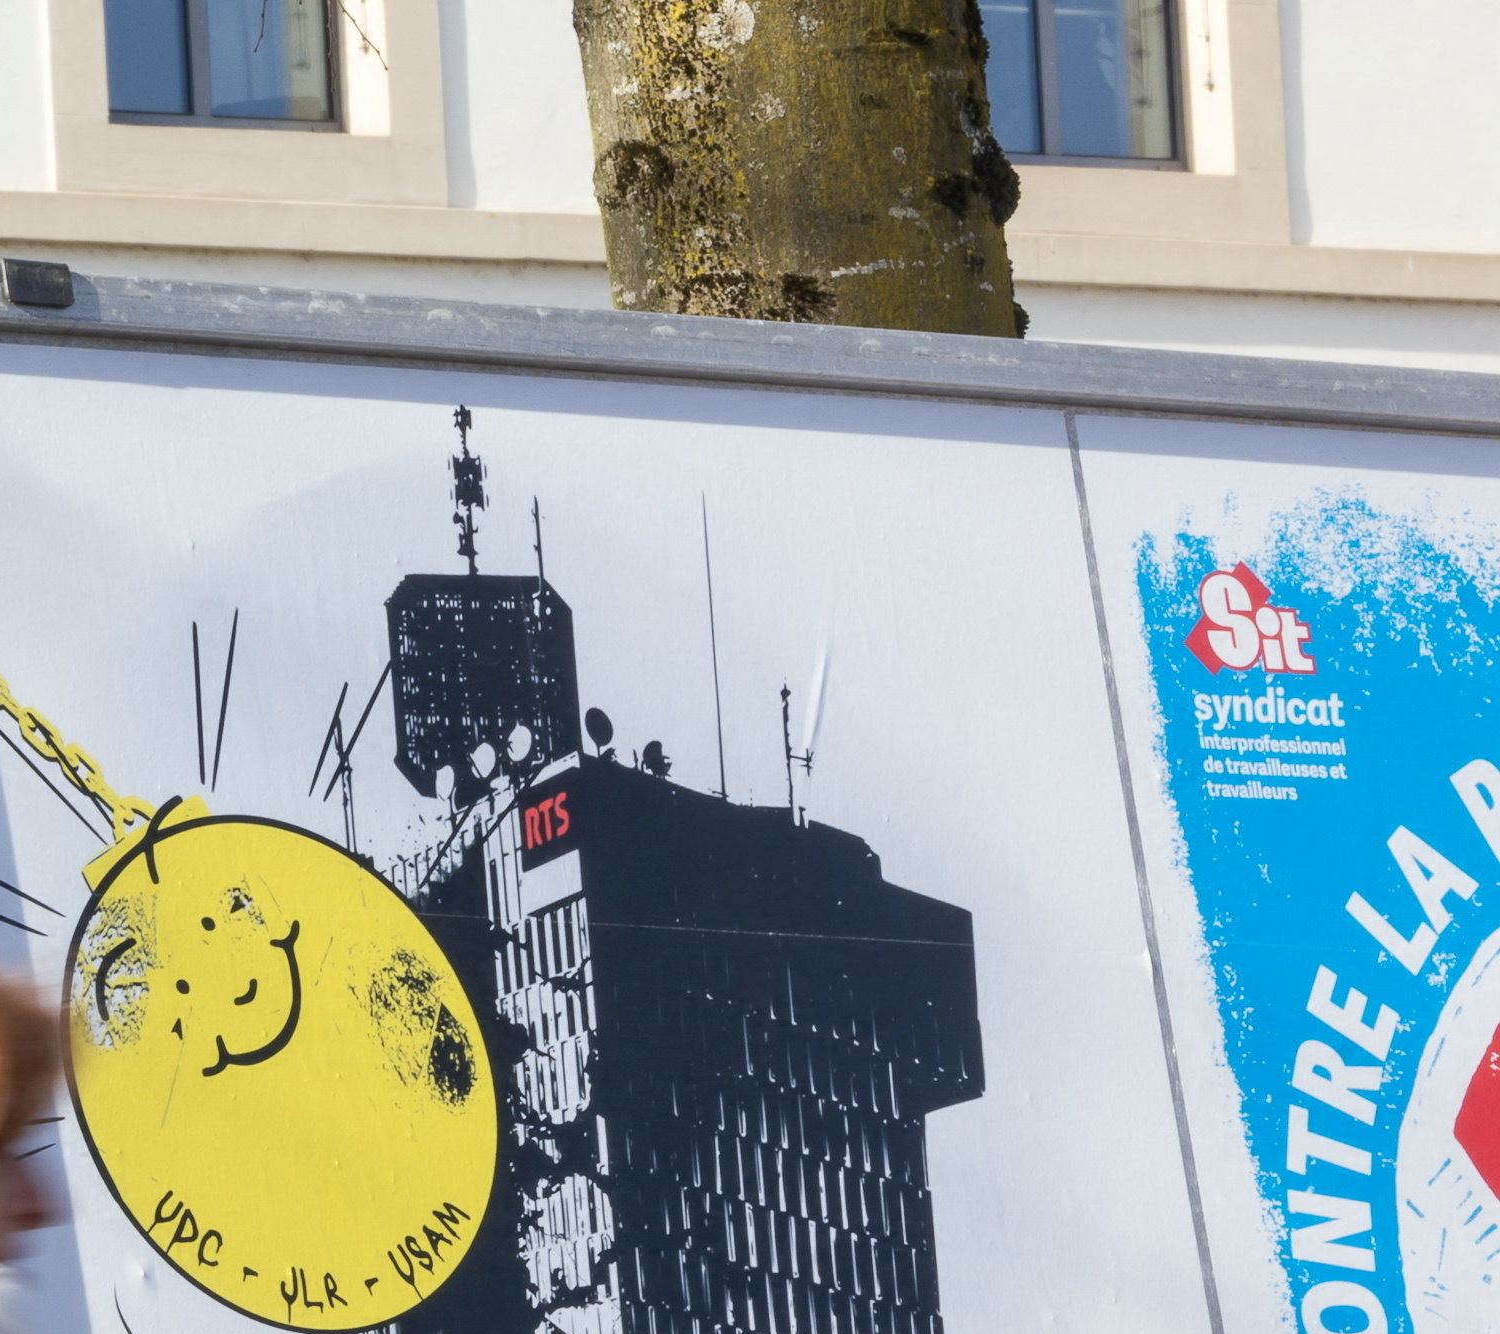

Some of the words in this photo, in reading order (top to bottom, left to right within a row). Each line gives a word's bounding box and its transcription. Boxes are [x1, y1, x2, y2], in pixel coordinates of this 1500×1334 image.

[1201, 574, 1314, 672] Sit
[1194, 686, 1345, 730] syndicat
[1200, 734, 1346, 756] interprofessionnel
[1203, 758, 1223, 774] de
[1225, 758, 1328, 779] travailleuses
[1330, 762, 1348, 779] et
[1207, 781, 1298, 800] travailleurs
[522, 792, 570, 850] RTS
[1345, 825, 1480, 974] LA
[148, 1190, 223, 1267] UDC
[387, 1202, 471, 1301] USAM
